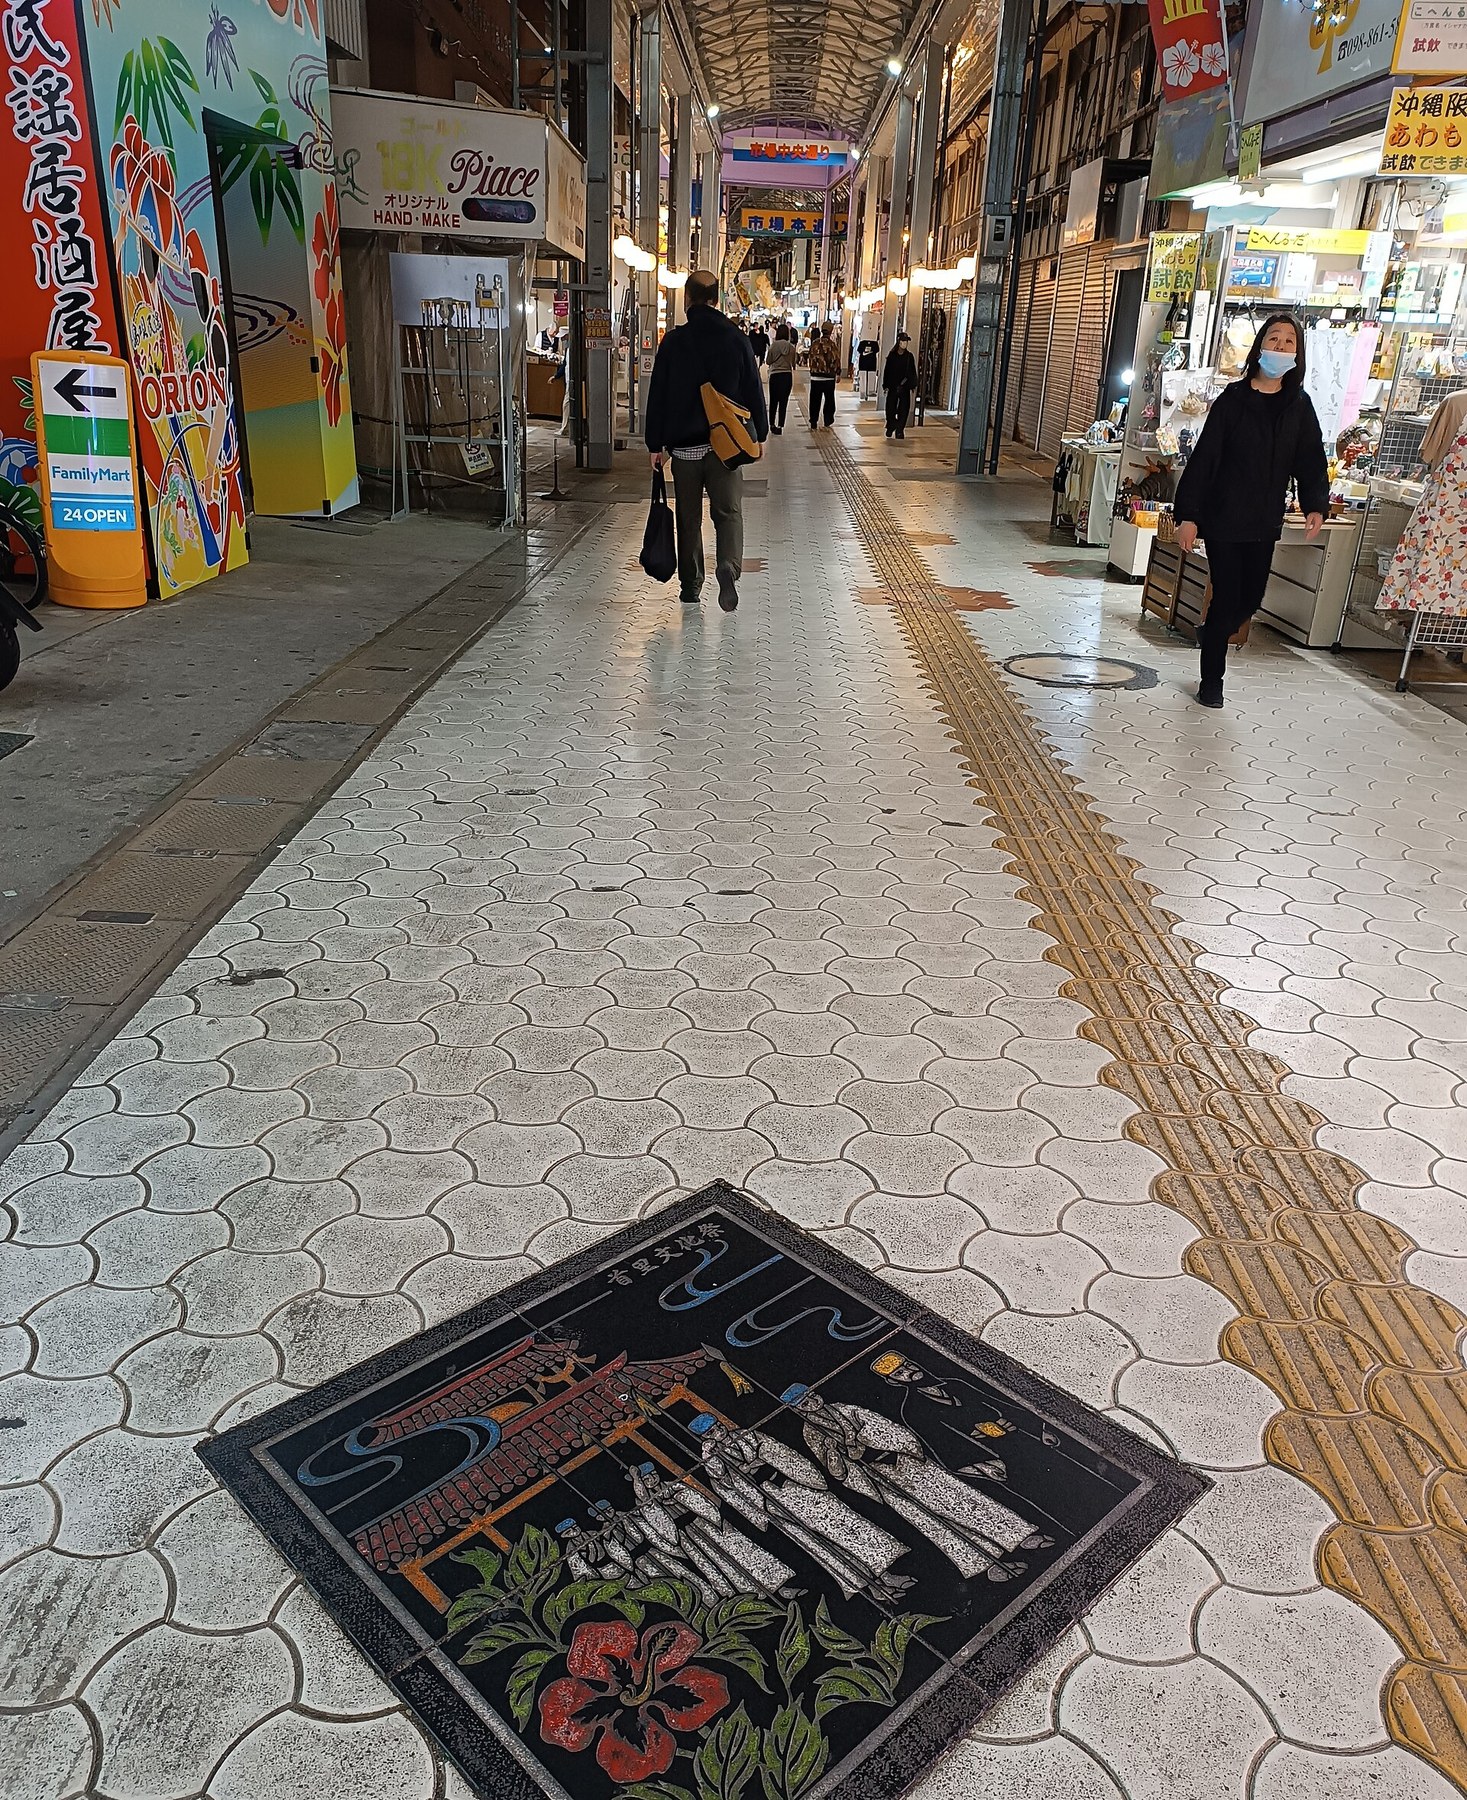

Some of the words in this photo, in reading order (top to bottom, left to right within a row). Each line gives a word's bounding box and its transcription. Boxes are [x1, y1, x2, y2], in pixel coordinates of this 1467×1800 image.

[1411, 37, 1441, 53] 試飲
[750, 142, 830, 160] 市場中央通り
[376, 140, 449, 195] 18K
[1380, 153, 1467, 171] 試飲できま
[384, 193, 449, 211] オリジナル
[1152, 268, 1194, 290] 試飲
[140, 368, 228, 420] ORION
[52, 466, 131, 483] FamilyMart
